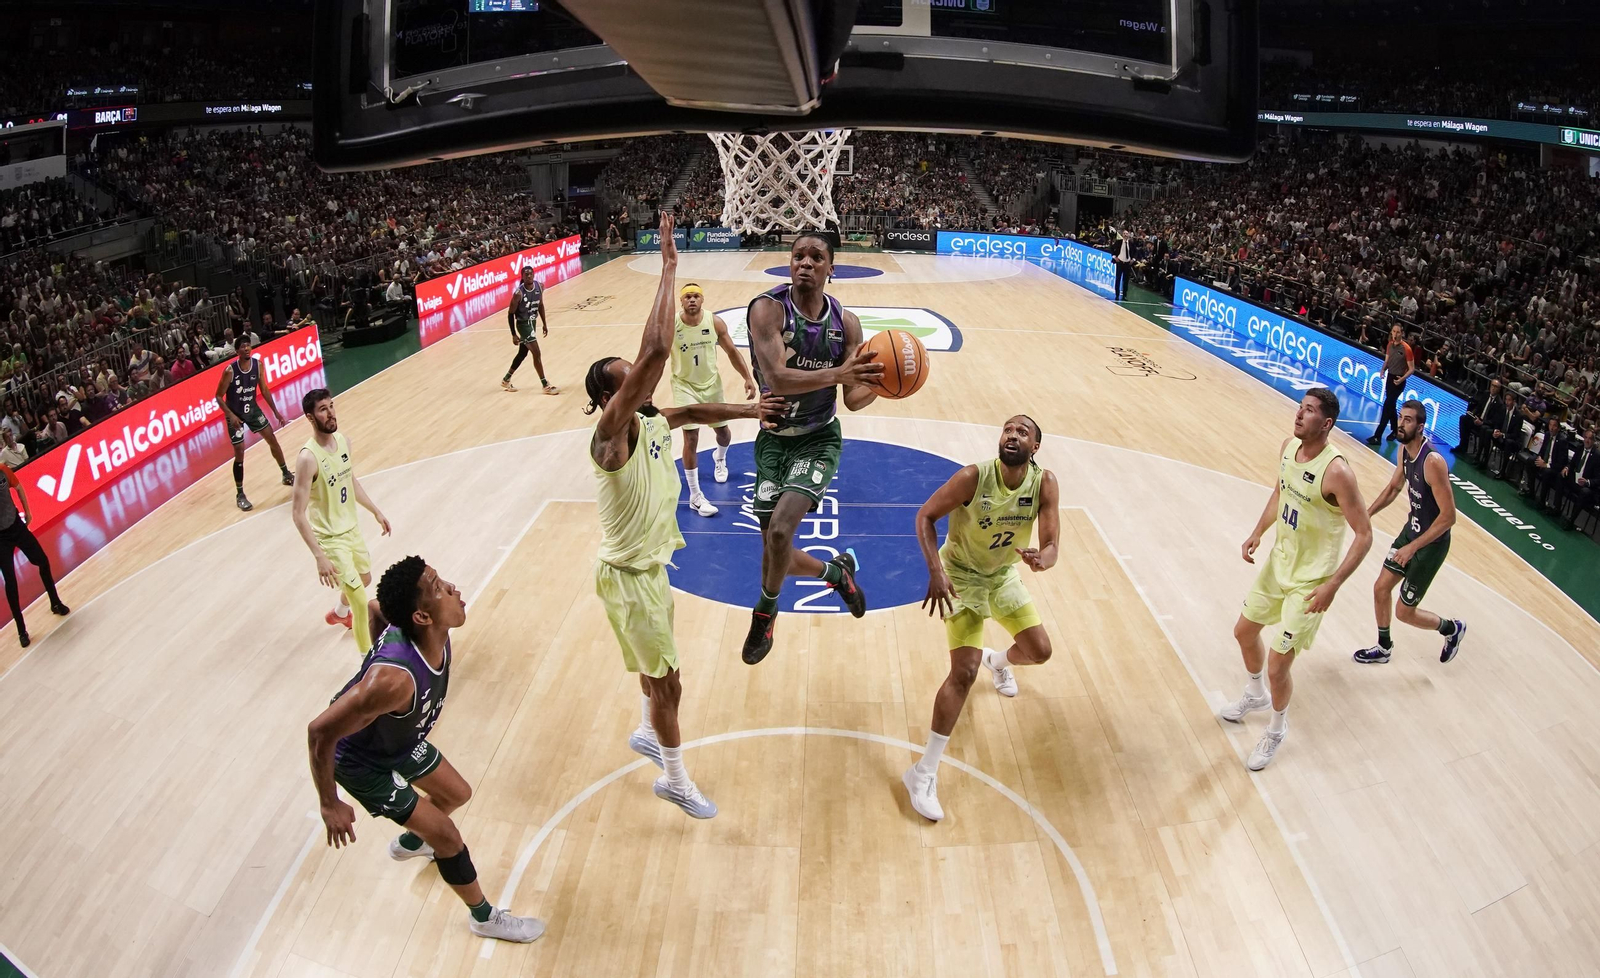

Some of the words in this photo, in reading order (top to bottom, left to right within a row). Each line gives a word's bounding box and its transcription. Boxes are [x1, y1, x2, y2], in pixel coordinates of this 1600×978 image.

[95, 110, 121, 125] BARÇA
[213, 106, 231, 114] espera
[241, 104, 261, 113] Málaga
[262, 104, 281, 113] Wagen
[1264, 113, 1284, 121] Málaga
[1284, 115, 1303, 123] Wagen
[1407, 119, 1413, 127] te
[1414, 120, 1432, 129] espera
[1441, 120, 1464, 131] Málaga
[1465, 122, 1488, 133] Wagen
[887, 231, 930, 241] endesa
[951, 236, 1026, 255] endesa
[522, 252, 546, 269] Halcón
[1041, 242, 1083, 262] endesa
[1086, 252, 1117, 277] endesa
[463, 269, 495, 295] Halcón
[494, 270, 508, 283] viajes
[423, 295, 443, 311] viajes
[1182, 288, 1237, 328] endesa
[1247, 315, 1322, 369] endesa
[693, 354, 699, 367] 1
[899, 332, 917, 376] Wilson
[243, 403, 250, 414] 6
[87, 407, 180, 481] Halcón
[180, 396, 219, 427] viajes
[340, 486, 347, 504] 8
[1281, 503, 1298, 531] 44
[1453, 480, 1537, 530] Miguel
[1528, 533, 1555, 550] 0,0
[989, 531, 1015, 550] 22
